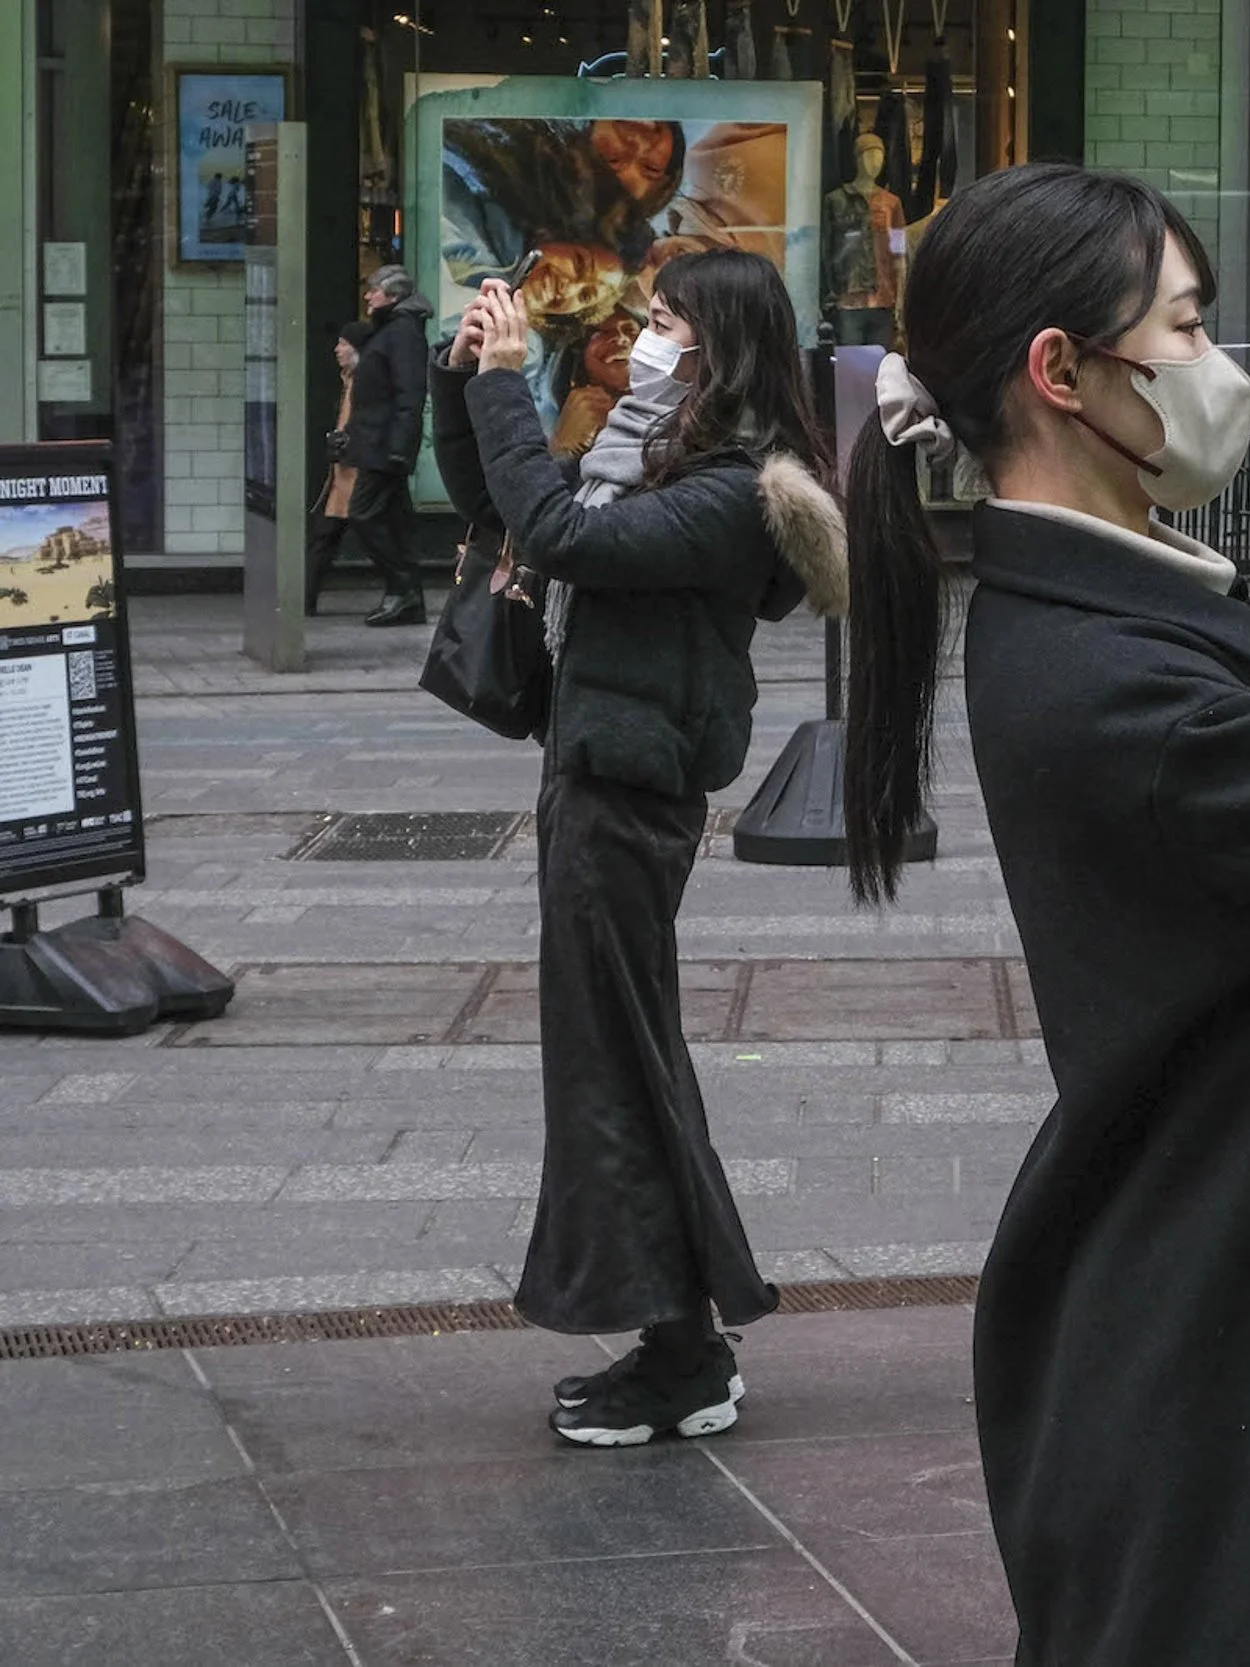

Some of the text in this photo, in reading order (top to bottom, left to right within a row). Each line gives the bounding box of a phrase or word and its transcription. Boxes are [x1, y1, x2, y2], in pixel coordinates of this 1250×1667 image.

[208, 100, 257, 123] SALE
[200, 126, 245, 149] AWA
[48, 474, 108, 497] MOMENT
